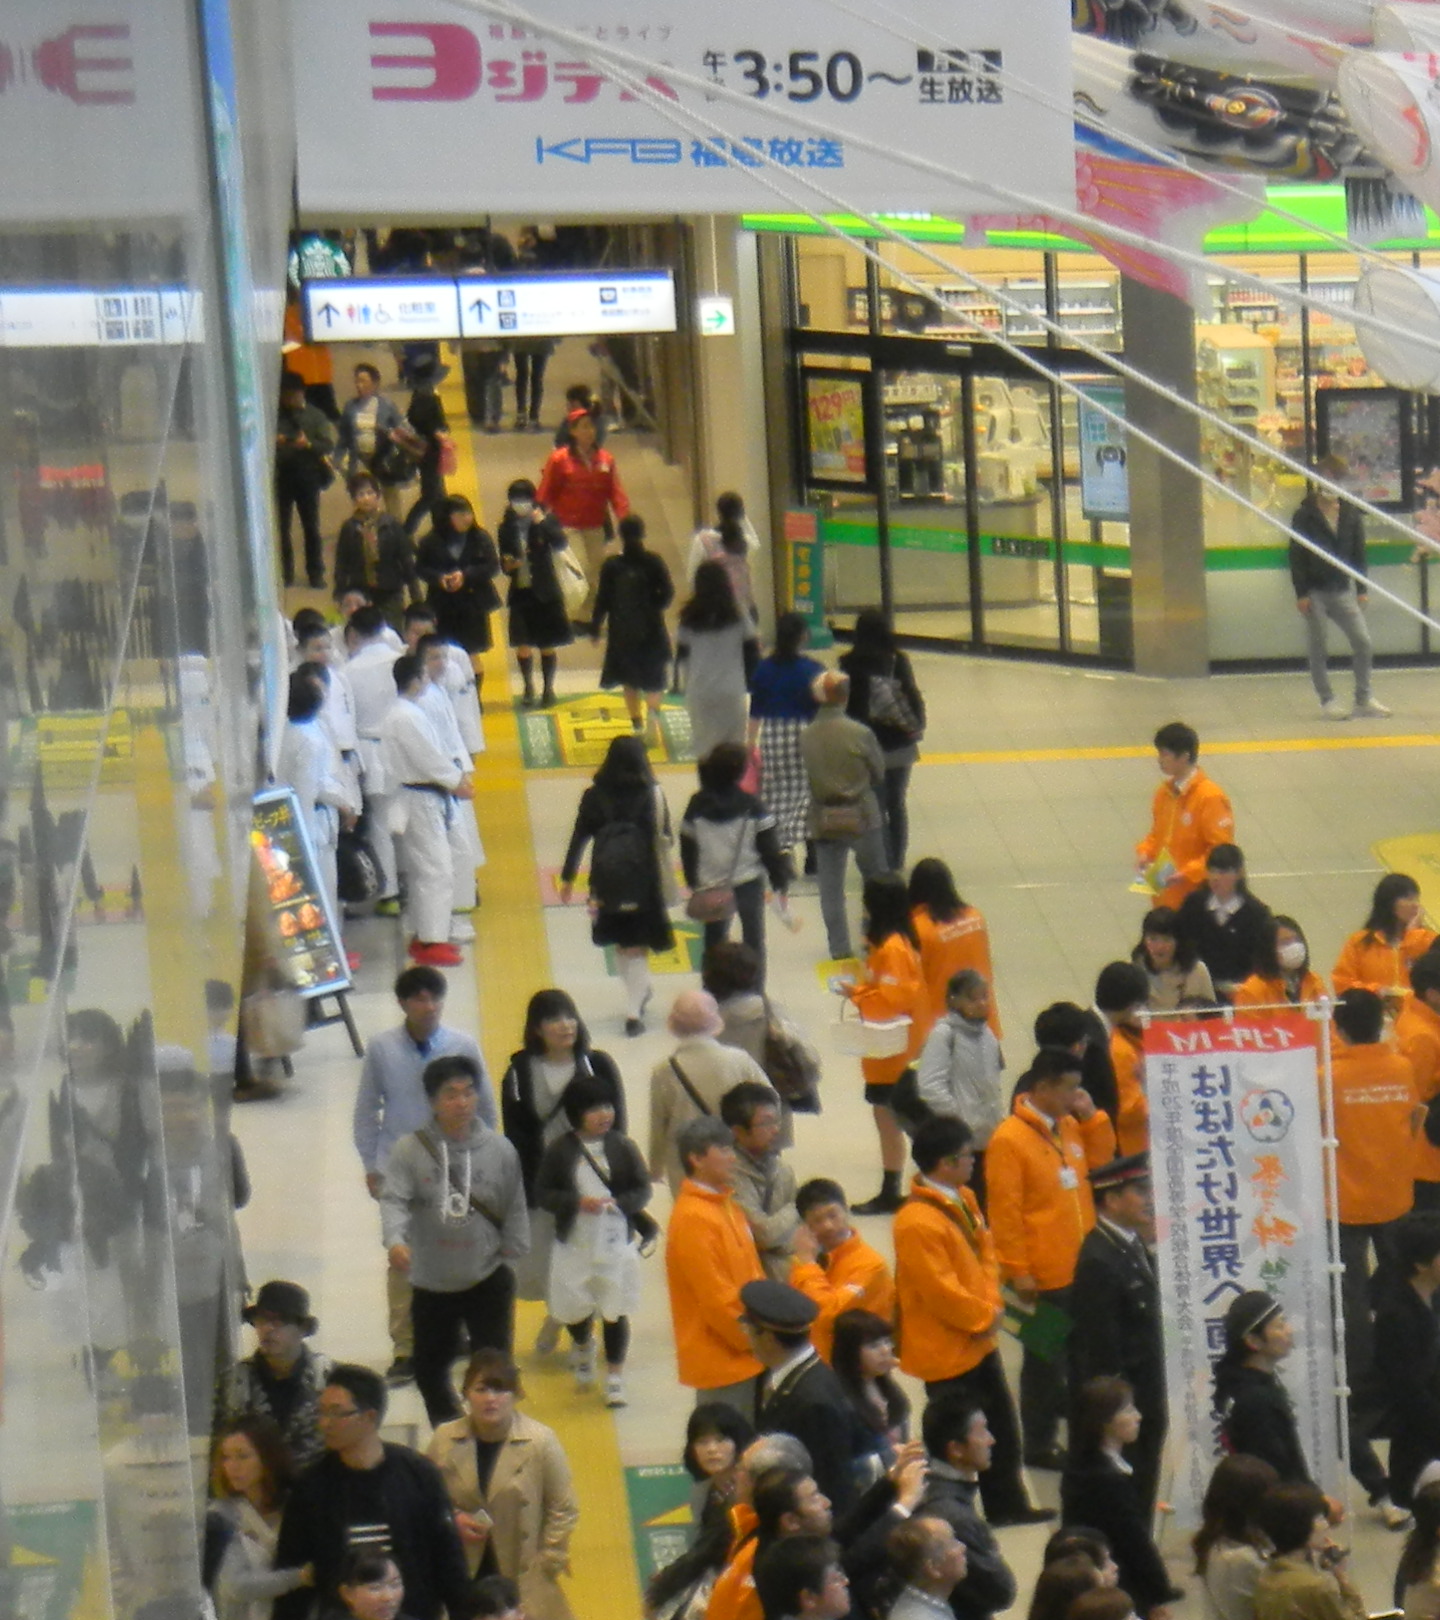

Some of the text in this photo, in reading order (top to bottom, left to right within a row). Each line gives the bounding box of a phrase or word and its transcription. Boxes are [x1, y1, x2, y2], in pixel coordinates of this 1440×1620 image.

[918, 77, 1004, 104] 生放送
[535, 136, 682, 164] KFB
